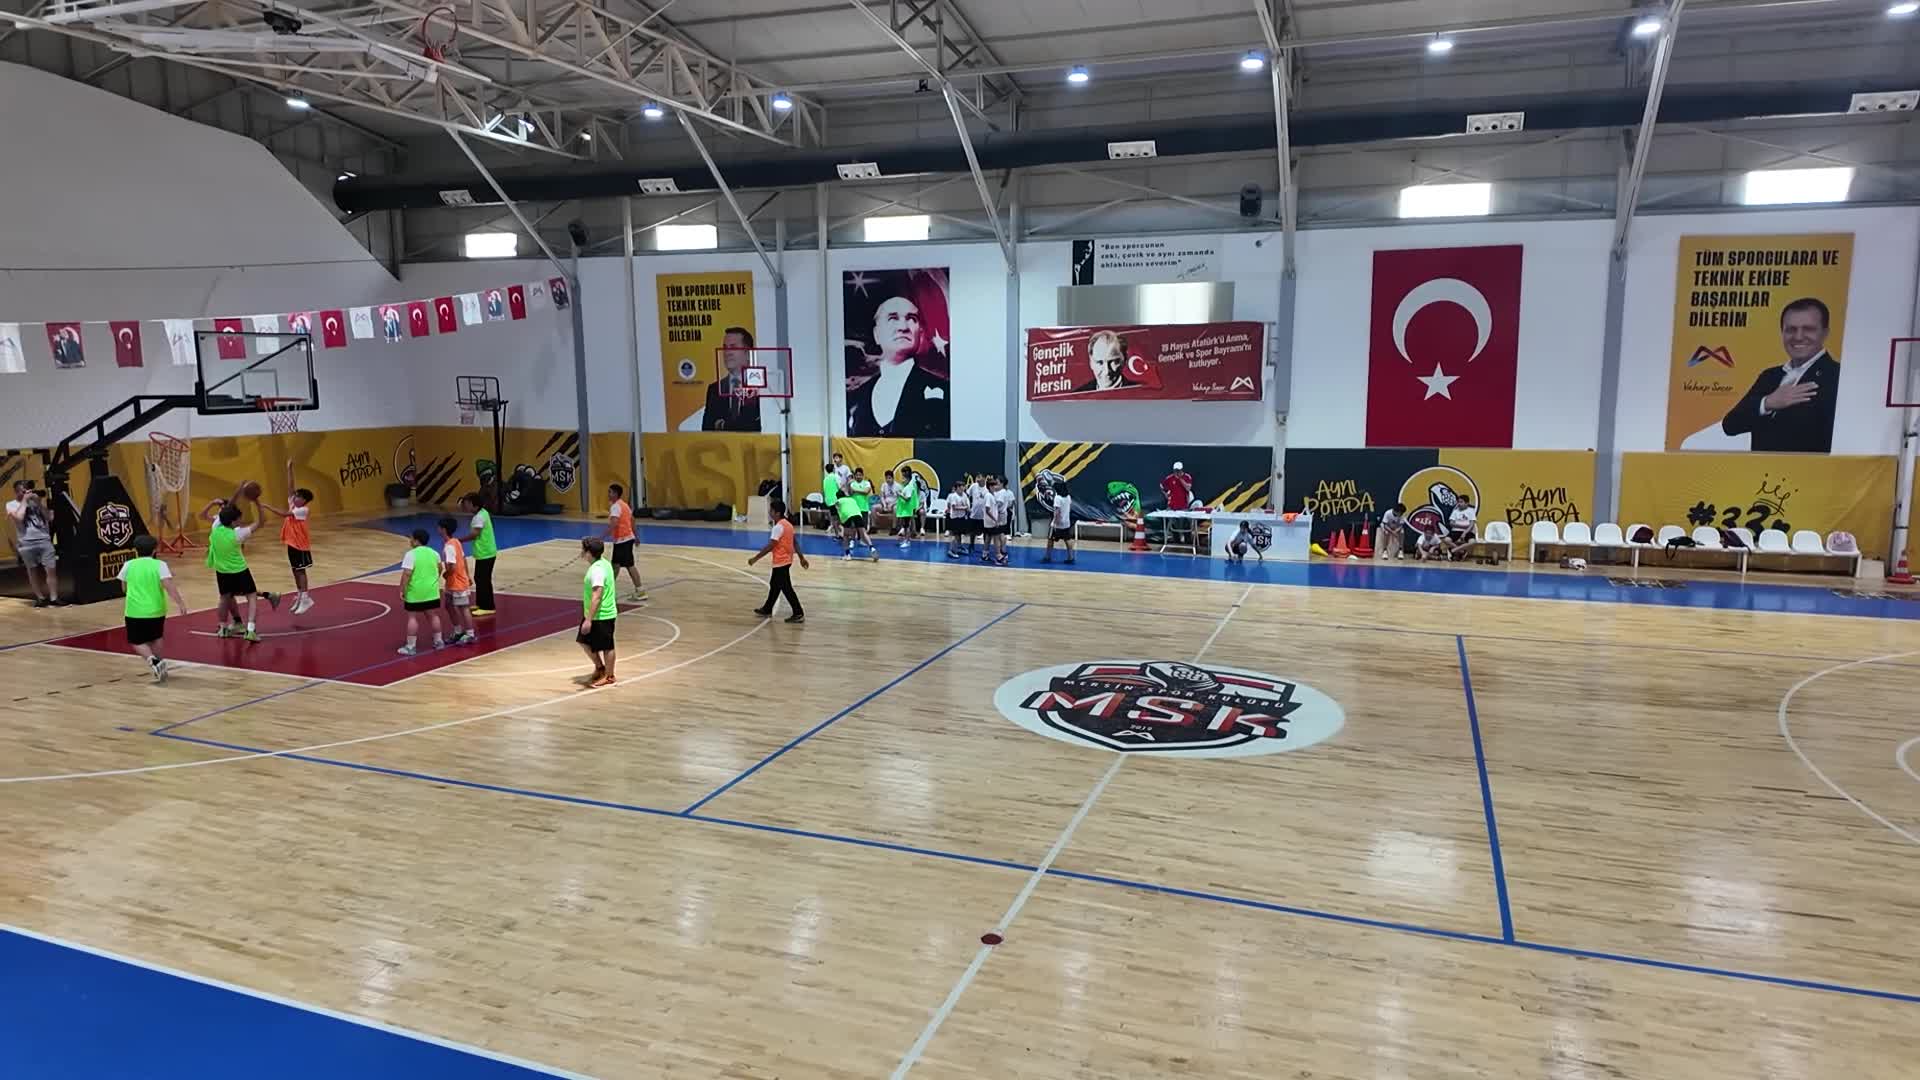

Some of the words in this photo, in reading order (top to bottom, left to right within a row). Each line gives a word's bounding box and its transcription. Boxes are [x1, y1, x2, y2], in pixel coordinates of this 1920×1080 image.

[1695, 249, 1724, 266] TÜM
[1728, 249, 1818, 266] SPORCULARA
[1822, 249, 1839, 265] VE
[1693, 268, 1744, 286] TEKNİK
[1748, 268, 1790, 286] EKİBE
[666, 284, 683, 297] TÜM
[684, 283, 735, 297] SPORCULARA
[736, 282, 747, 295] VE
[667, 298, 696, 312] TEKNİK
[698, 297, 721, 311] EKİBE
[1691, 291, 1770, 309] BAŞARILAR
[668, 314, 712, 328] BAŞARILAR
[1689, 309, 1747, 327] DİLERİM
[669, 328, 702, 342] DİLERİM
[1033, 342, 1074, 361] Gençlik
[1170, 341, 1190, 351] Mayıs
[1158, 352, 1184, 363] Gençlik
[1186, 351, 1194, 359] ve
[1196, 348, 1212, 359] Spor
[1036, 359, 1066, 378] Şehri
[1034, 376, 1071, 394] Mersin
[101, 521, 130, 537] MSK
[1029, 691, 1280, 737] MSK
